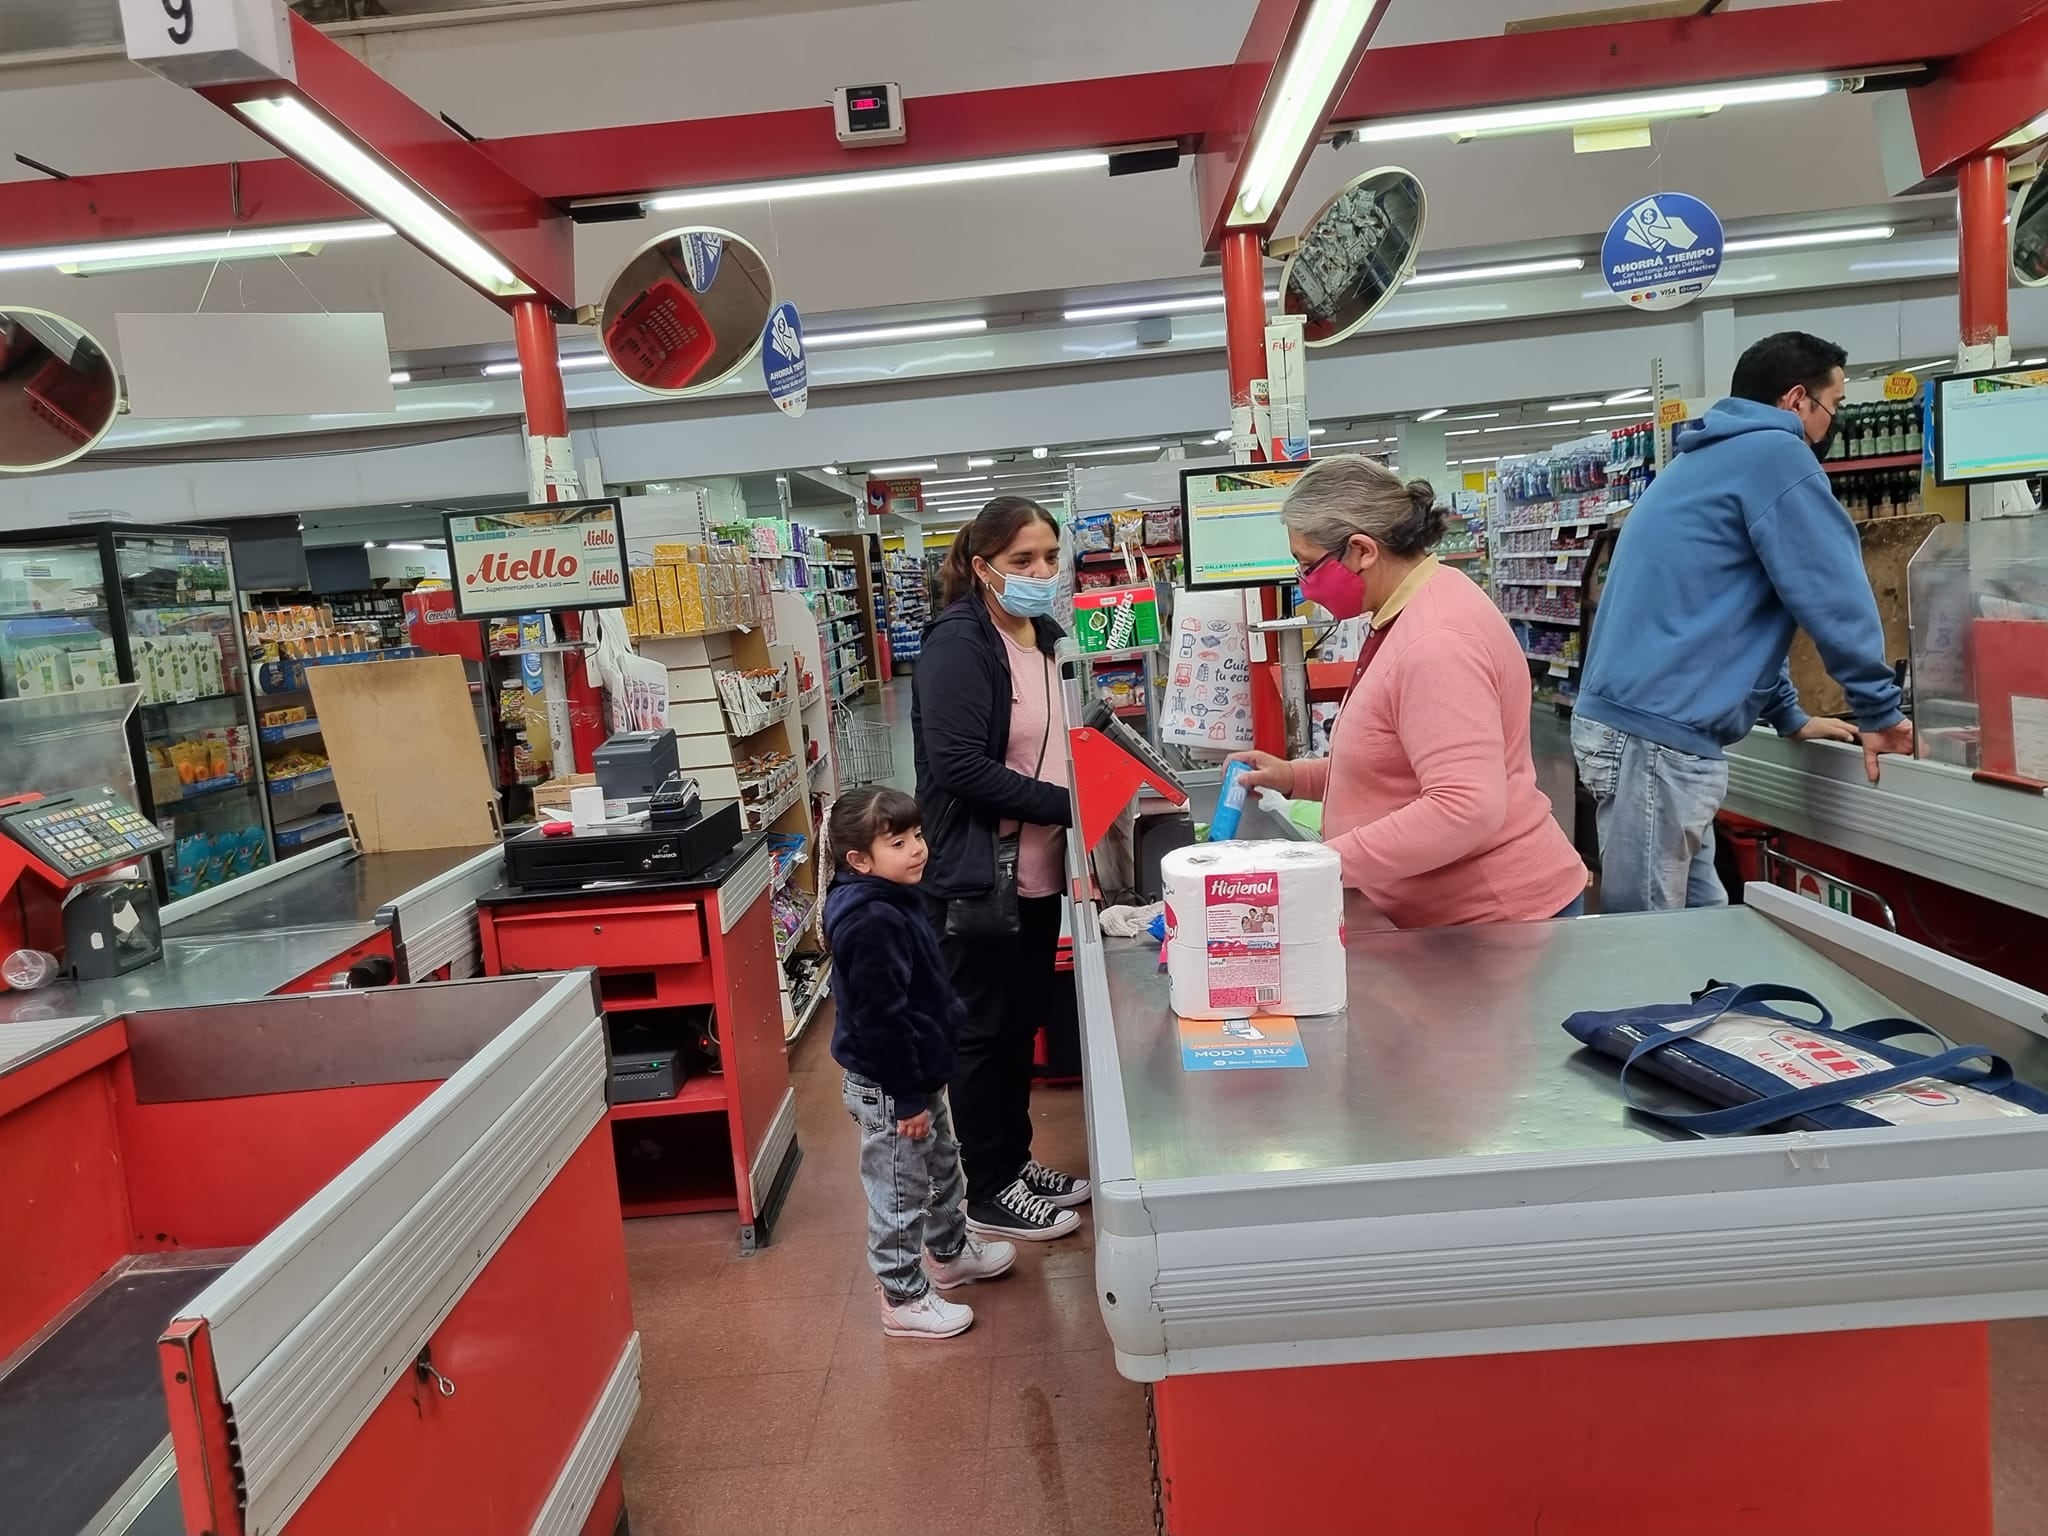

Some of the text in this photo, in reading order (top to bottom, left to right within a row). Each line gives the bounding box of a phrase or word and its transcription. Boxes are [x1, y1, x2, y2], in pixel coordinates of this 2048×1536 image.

[162, 0, 193, 45] 9
[1612, 247, 1715, 274] AHORRÁ TIEMPO
[1612, 278, 1631, 287] retirá
[1633, 275, 1652, 283] hasta
[1687, 263, 1717, 273] efectivo
[1645, 266, 1668, 276] compra
[1660, 287, 1677, 296] VISA
[770, 364, 793, 381] AHORRÁ
[890, 485, 917, 493] PRECIO
[583, 529, 615, 547] Aiello
[466, 548, 578, 586] Aiello
[485, 582, 535, 593] Supermercados
[549, 580, 562, 588] Luis
[588, 568, 620, 587] Aiello
[1215, 668, 1226, 682] tu
[1211, 877, 1273, 899] Higienol
[1194, 1049, 1246, 1058] MODO
[1777, 1062, 1811, 1081] Super
